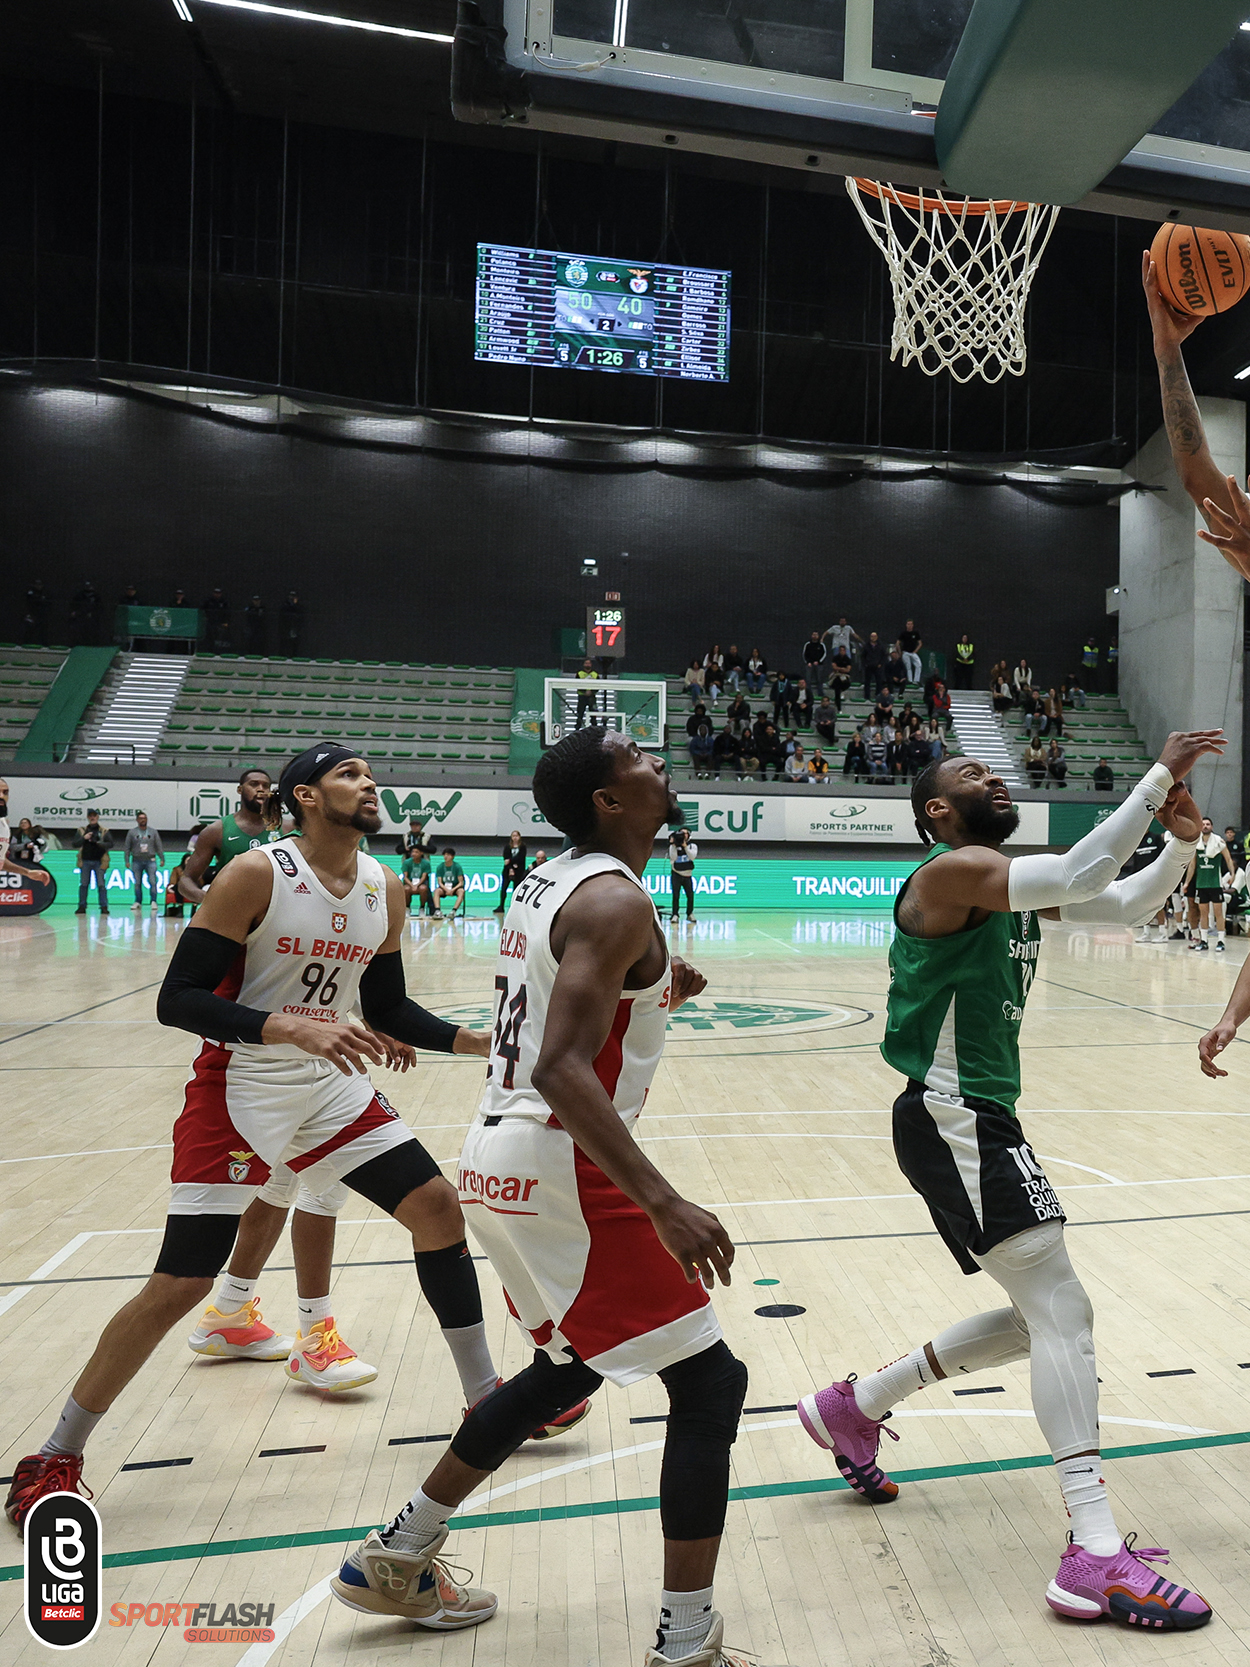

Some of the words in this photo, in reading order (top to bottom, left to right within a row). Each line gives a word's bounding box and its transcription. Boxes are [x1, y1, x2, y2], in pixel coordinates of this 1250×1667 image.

[490, 249, 519, 258] Williams
[1179, 242, 1207, 310] Wilson
[490, 284, 516, 292] Ventura
[489, 301, 524, 310] Fernandes
[568, 291, 593, 310] 50
[617, 297, 642, 315] 40
[489, 318, 505, 326] Cruz
[602, 320, 610, 331] 2
[560, 350, 569, 361] 5
[586, 349, 624, 366] 1:26
[639, 358, 647, 369] 5
[594, 610, 622, 621] 1:26
[592, 626, 622, 646] 17
[34, 807, 83, 816] SPORTS
[399, 806, 447, 817] LeasePlan
[704, 801, 764, 833] cuf
[810, 823, 848, 831] SPORTS
[850, 823, 893, 832] PARTNER
[276, 937, 305, 955] SL
[310, 939, 374, 965] BENFIC
[301, 963, 338, 1006] 96
[1021, 1178, 1053, 1195] TRA
[1029, 1190, 1060, 1208] QUIL
